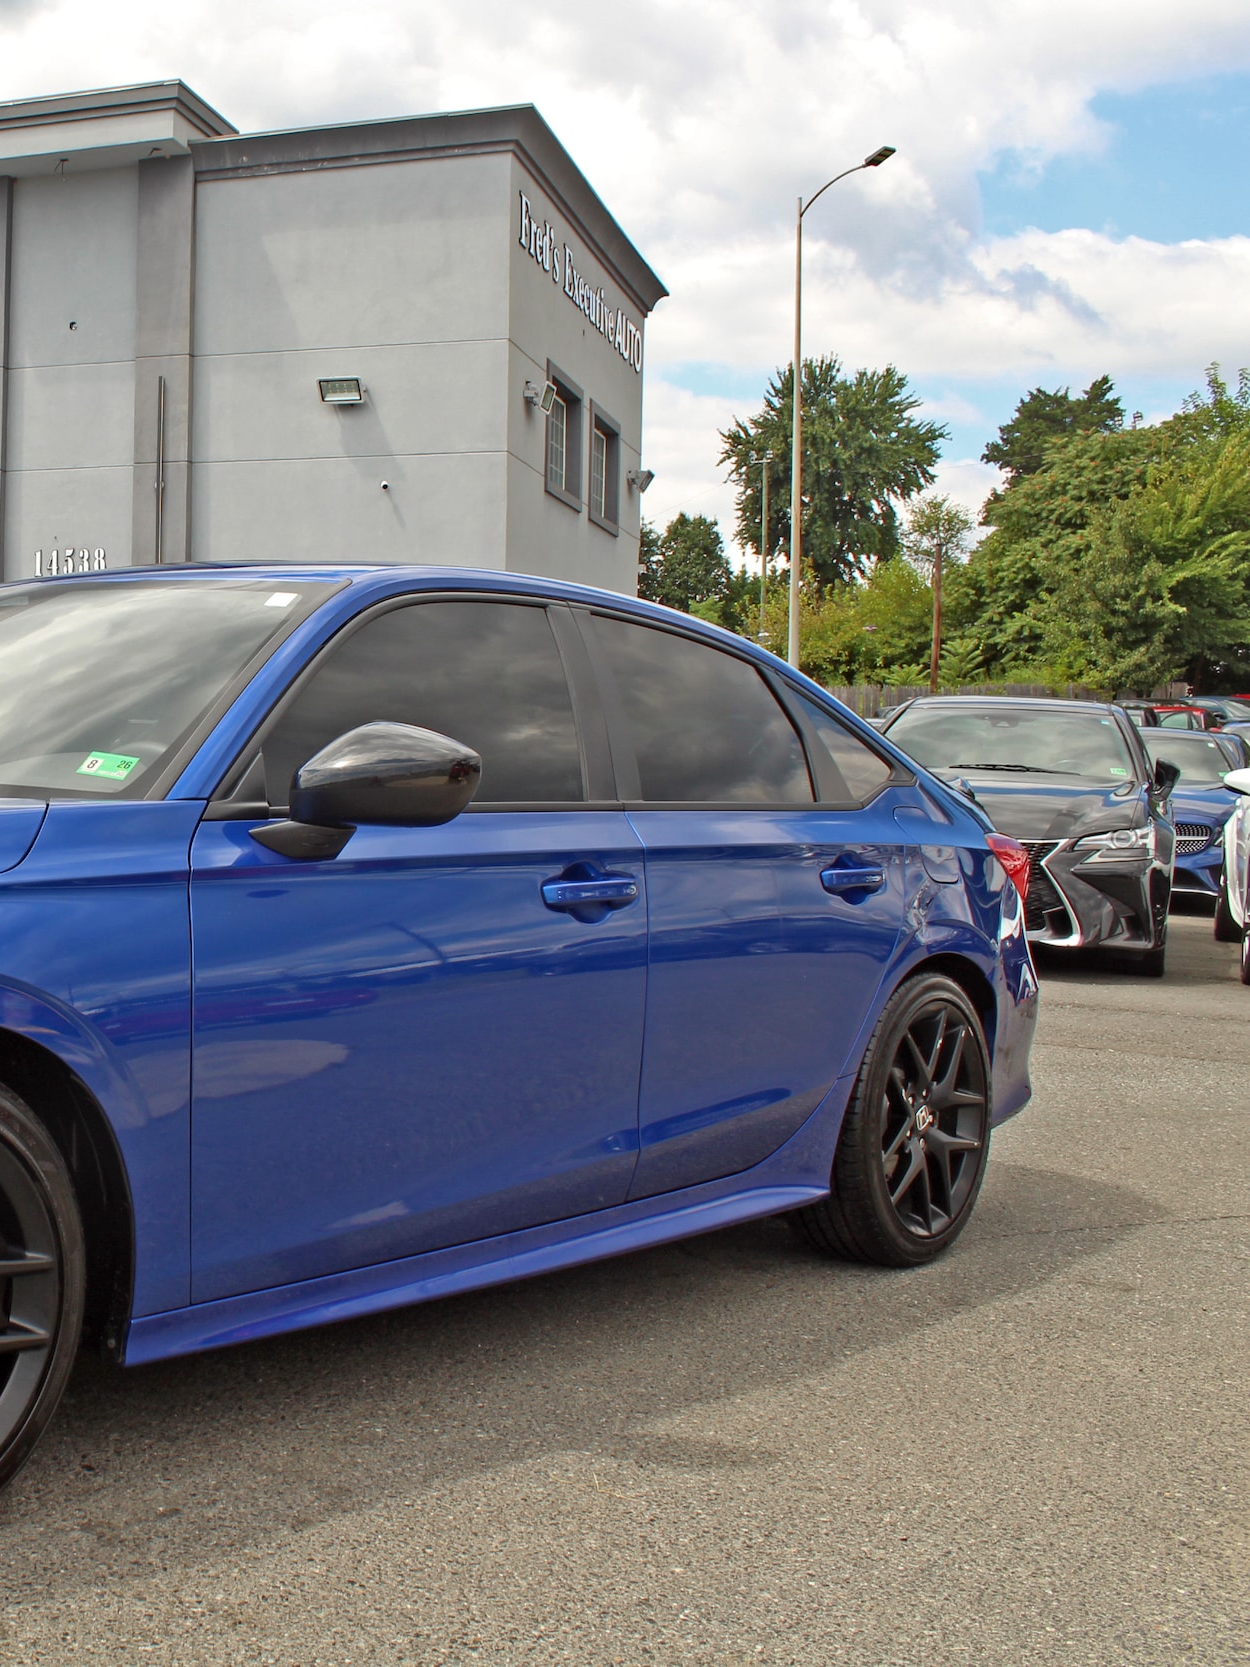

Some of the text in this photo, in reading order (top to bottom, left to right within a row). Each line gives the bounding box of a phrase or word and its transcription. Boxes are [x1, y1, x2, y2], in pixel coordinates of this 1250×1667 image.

[518, 190, 643, 374] Fred's Executive AUTO
[34, 547, 107, 577] 14538
